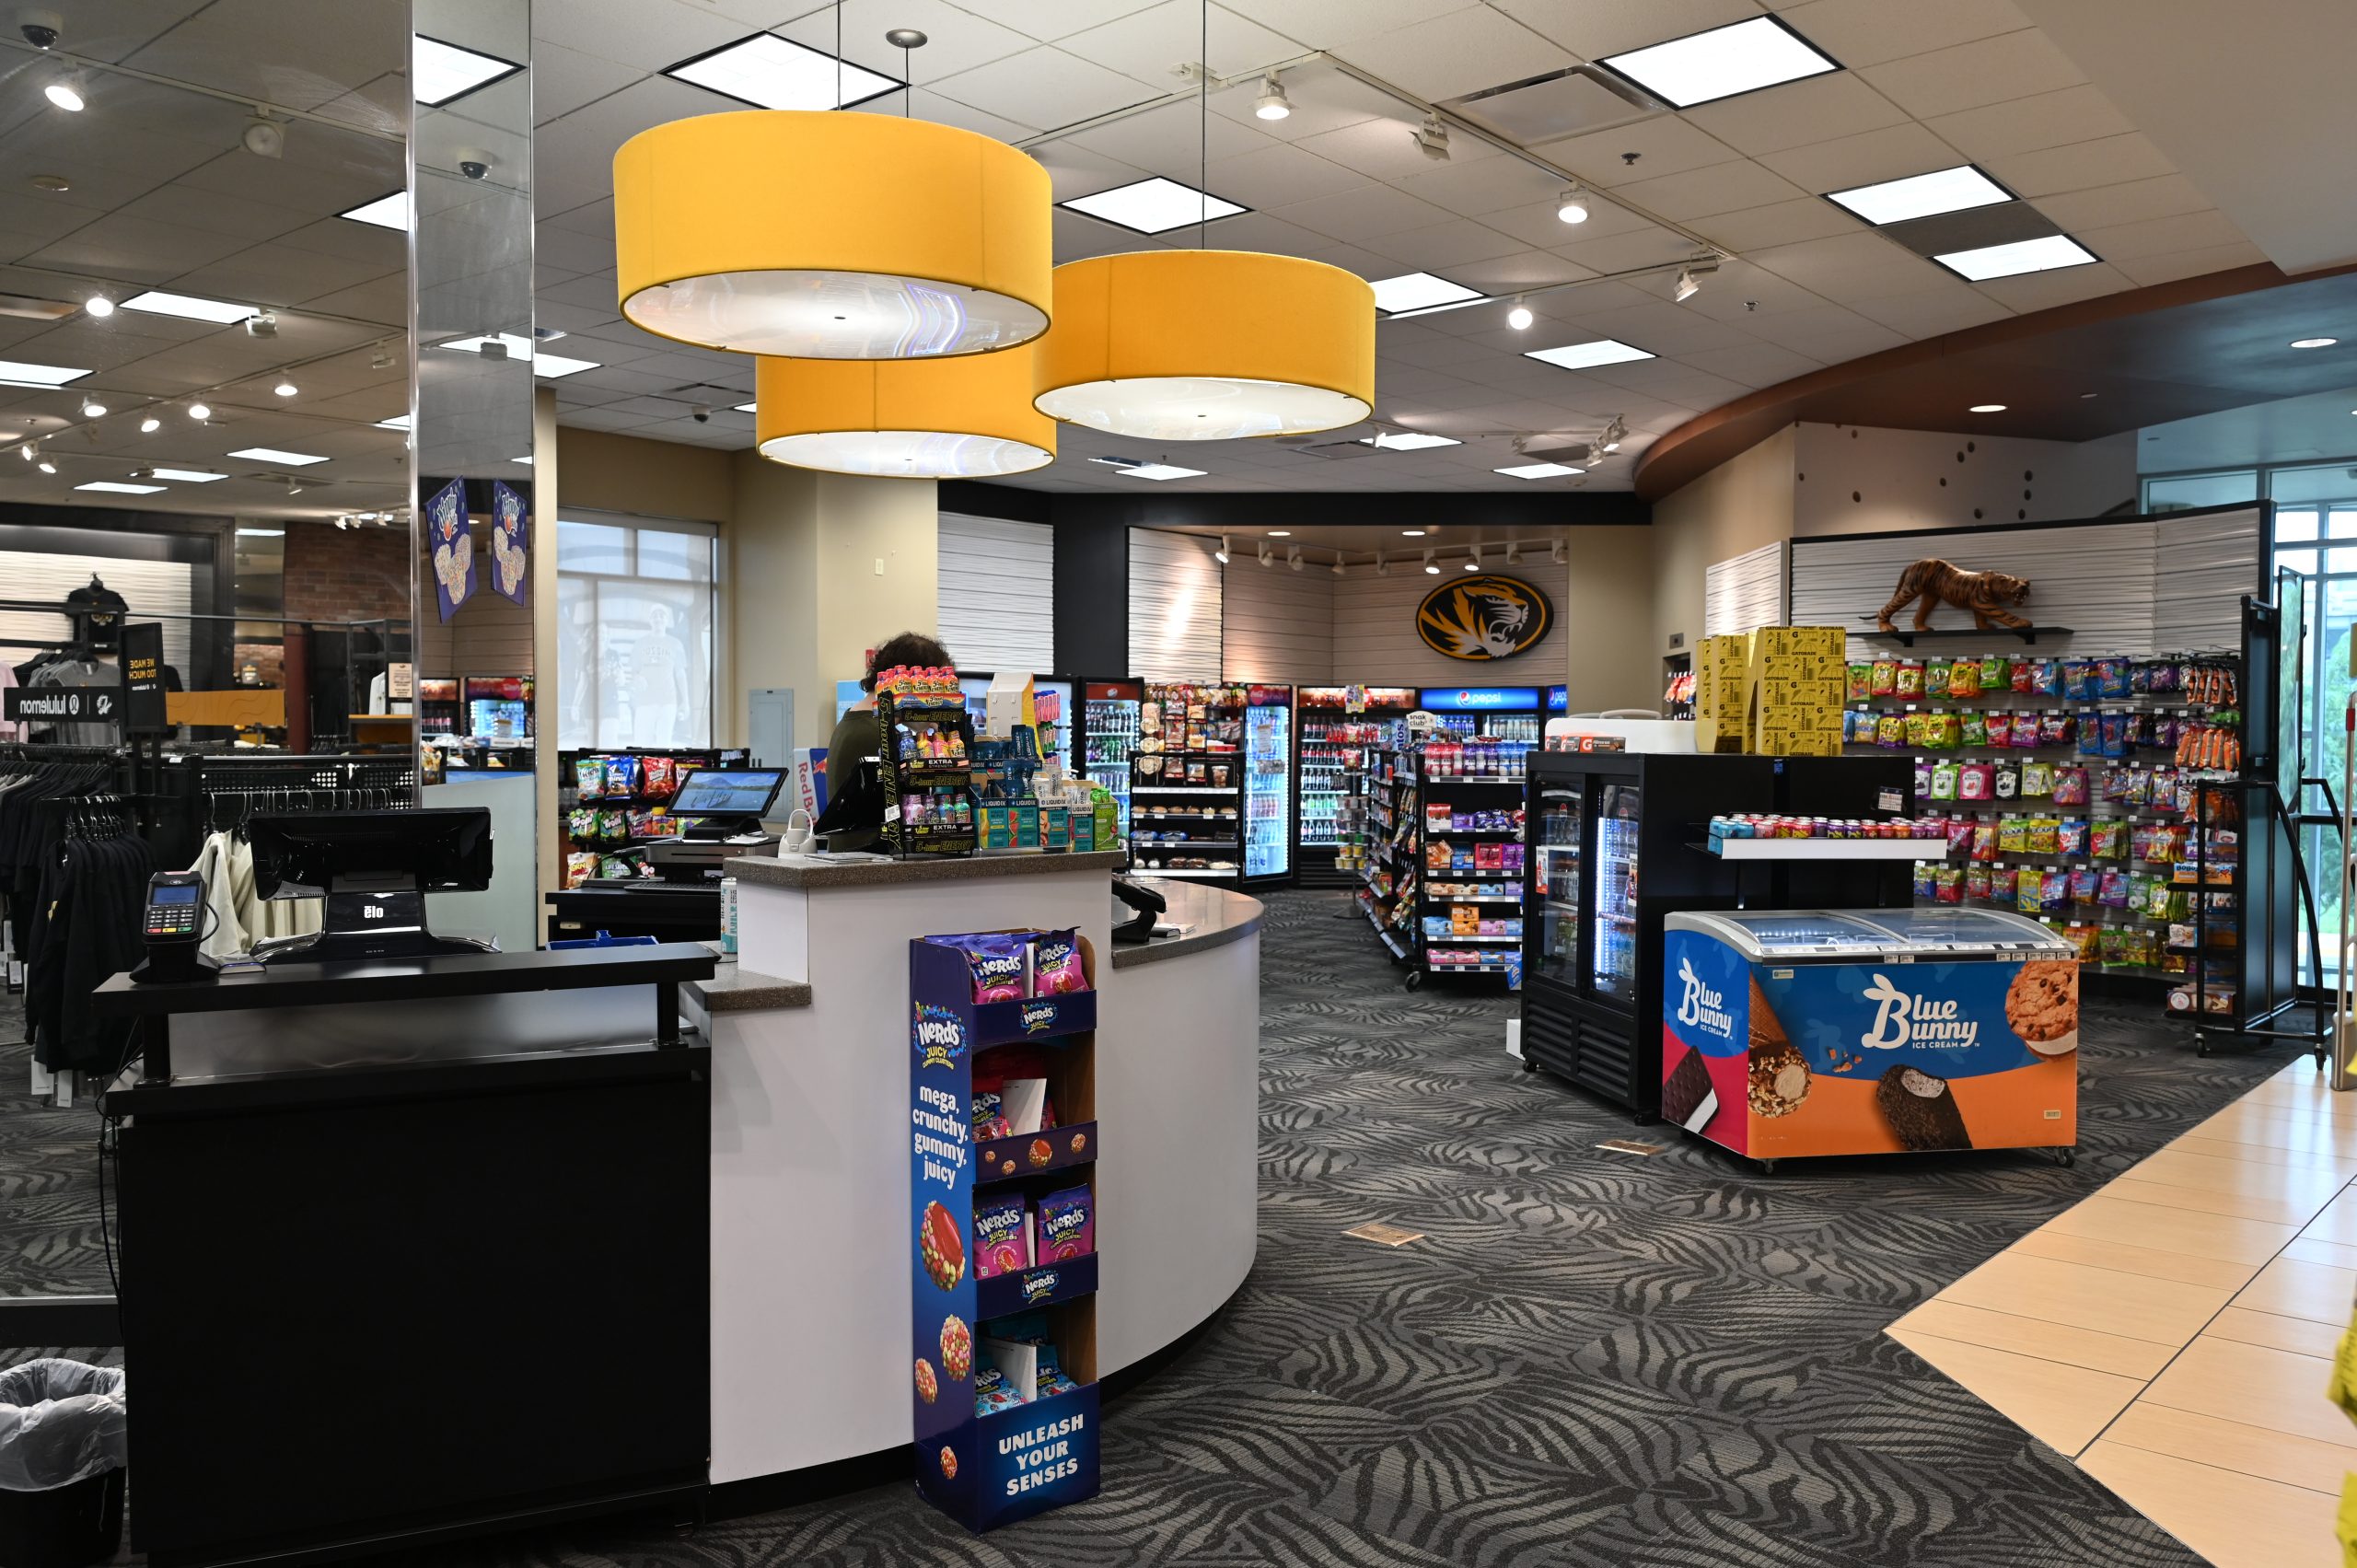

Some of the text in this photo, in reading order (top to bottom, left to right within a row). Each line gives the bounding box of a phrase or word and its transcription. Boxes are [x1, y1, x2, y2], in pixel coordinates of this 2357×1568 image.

[1472, 692, 1502, 705] pepsi
[929, 711, 963, 721] ENERGY
[1582, 738, 1593, 750] G
[797, 761, 812, 795] Red
[934, 775, 968, 785] ENERGY
[883, 760, 901, 850] ENEGY
[571, 816, 594, 828] Trolli
[603, 816, 622, 829] Trolli
[940, 840, 973, 851] ENERGY
[1040, 960, 1062, 971] JUICY
[986, 974, 1011, 984] JUICY
[1030, 1020, 1046, 1029] JUICY
[1708, 1027, 1723, 1037] CREAM
[926, 1046, 947, 1059] JUICY
[923, 1057, 956, 1071] GUMMY CLUSTERS
[920, 1086, 960, 1114] mega,
[912, 1109, 969, 1144] crunchy,
[914, 1132, 968, 1168] gummy,
[923, 1155, 957, 1191] juicy
[988, 1229, 1008, 1242] JUICY
[1055, 1228, 1076, 1241] JUICY
[1031, 1288, 1046, 1298] JUICY
[999, 1413, 1085, 1455] UNLEASH
[1016, 1441, 1069, 1470] YOUR
[1006, 1458, 1078, 1496] SENSES
